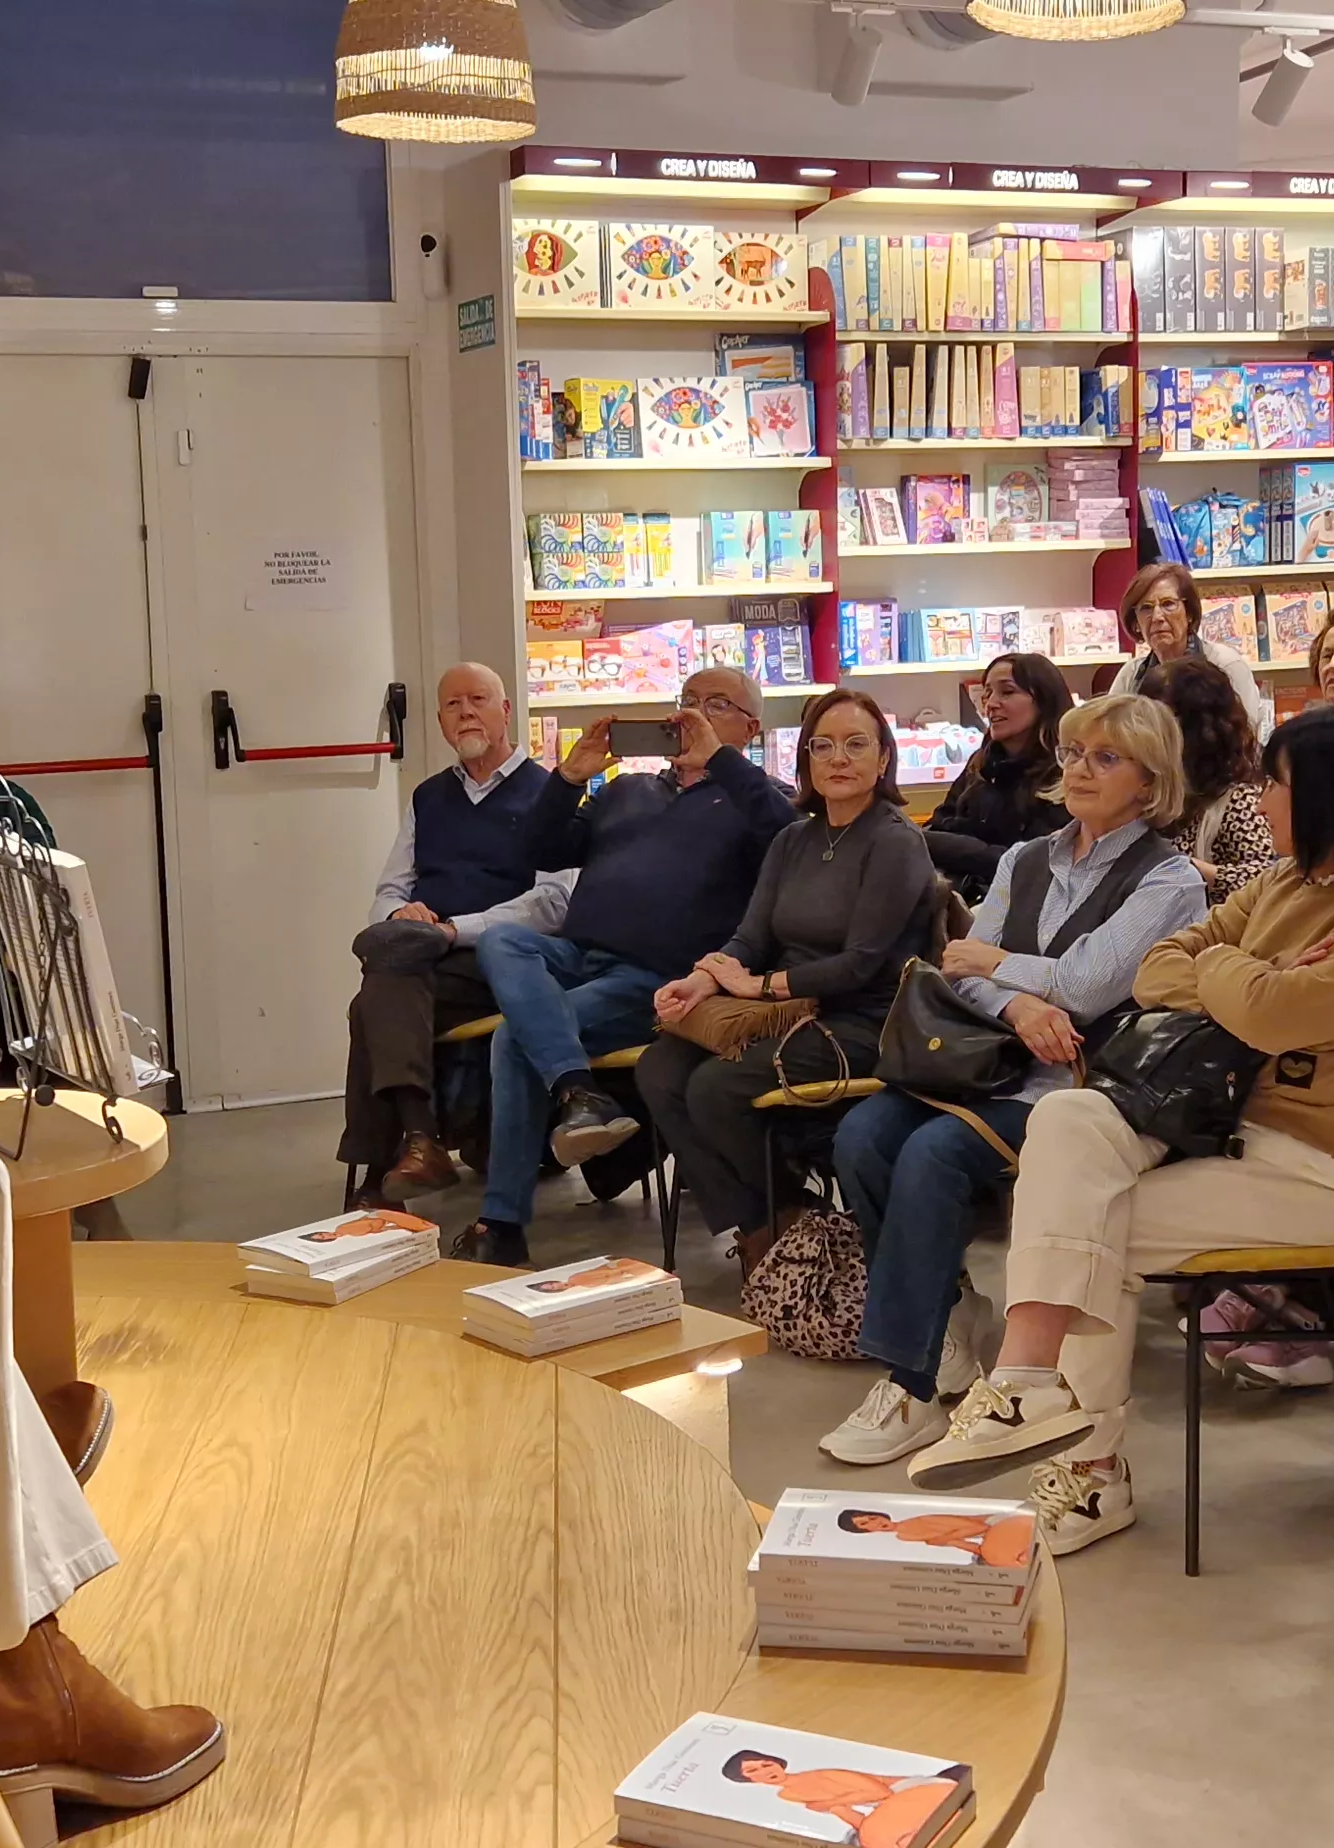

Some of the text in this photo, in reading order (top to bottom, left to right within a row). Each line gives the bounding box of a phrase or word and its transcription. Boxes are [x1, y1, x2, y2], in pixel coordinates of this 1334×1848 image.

[660, 158, 756, 179] CREA Y DISEÑA
[992, 169, 1079, 190] CREA Y DISEÑA
[1289, 176, 1319, 193] CREA
[1319, 177, 1328, 194] Y
[277, 560, 319, 568] BLOQUEAR
[278, 568, 306, 576] SALIDA
[744, 605, 777, 619] MODA
